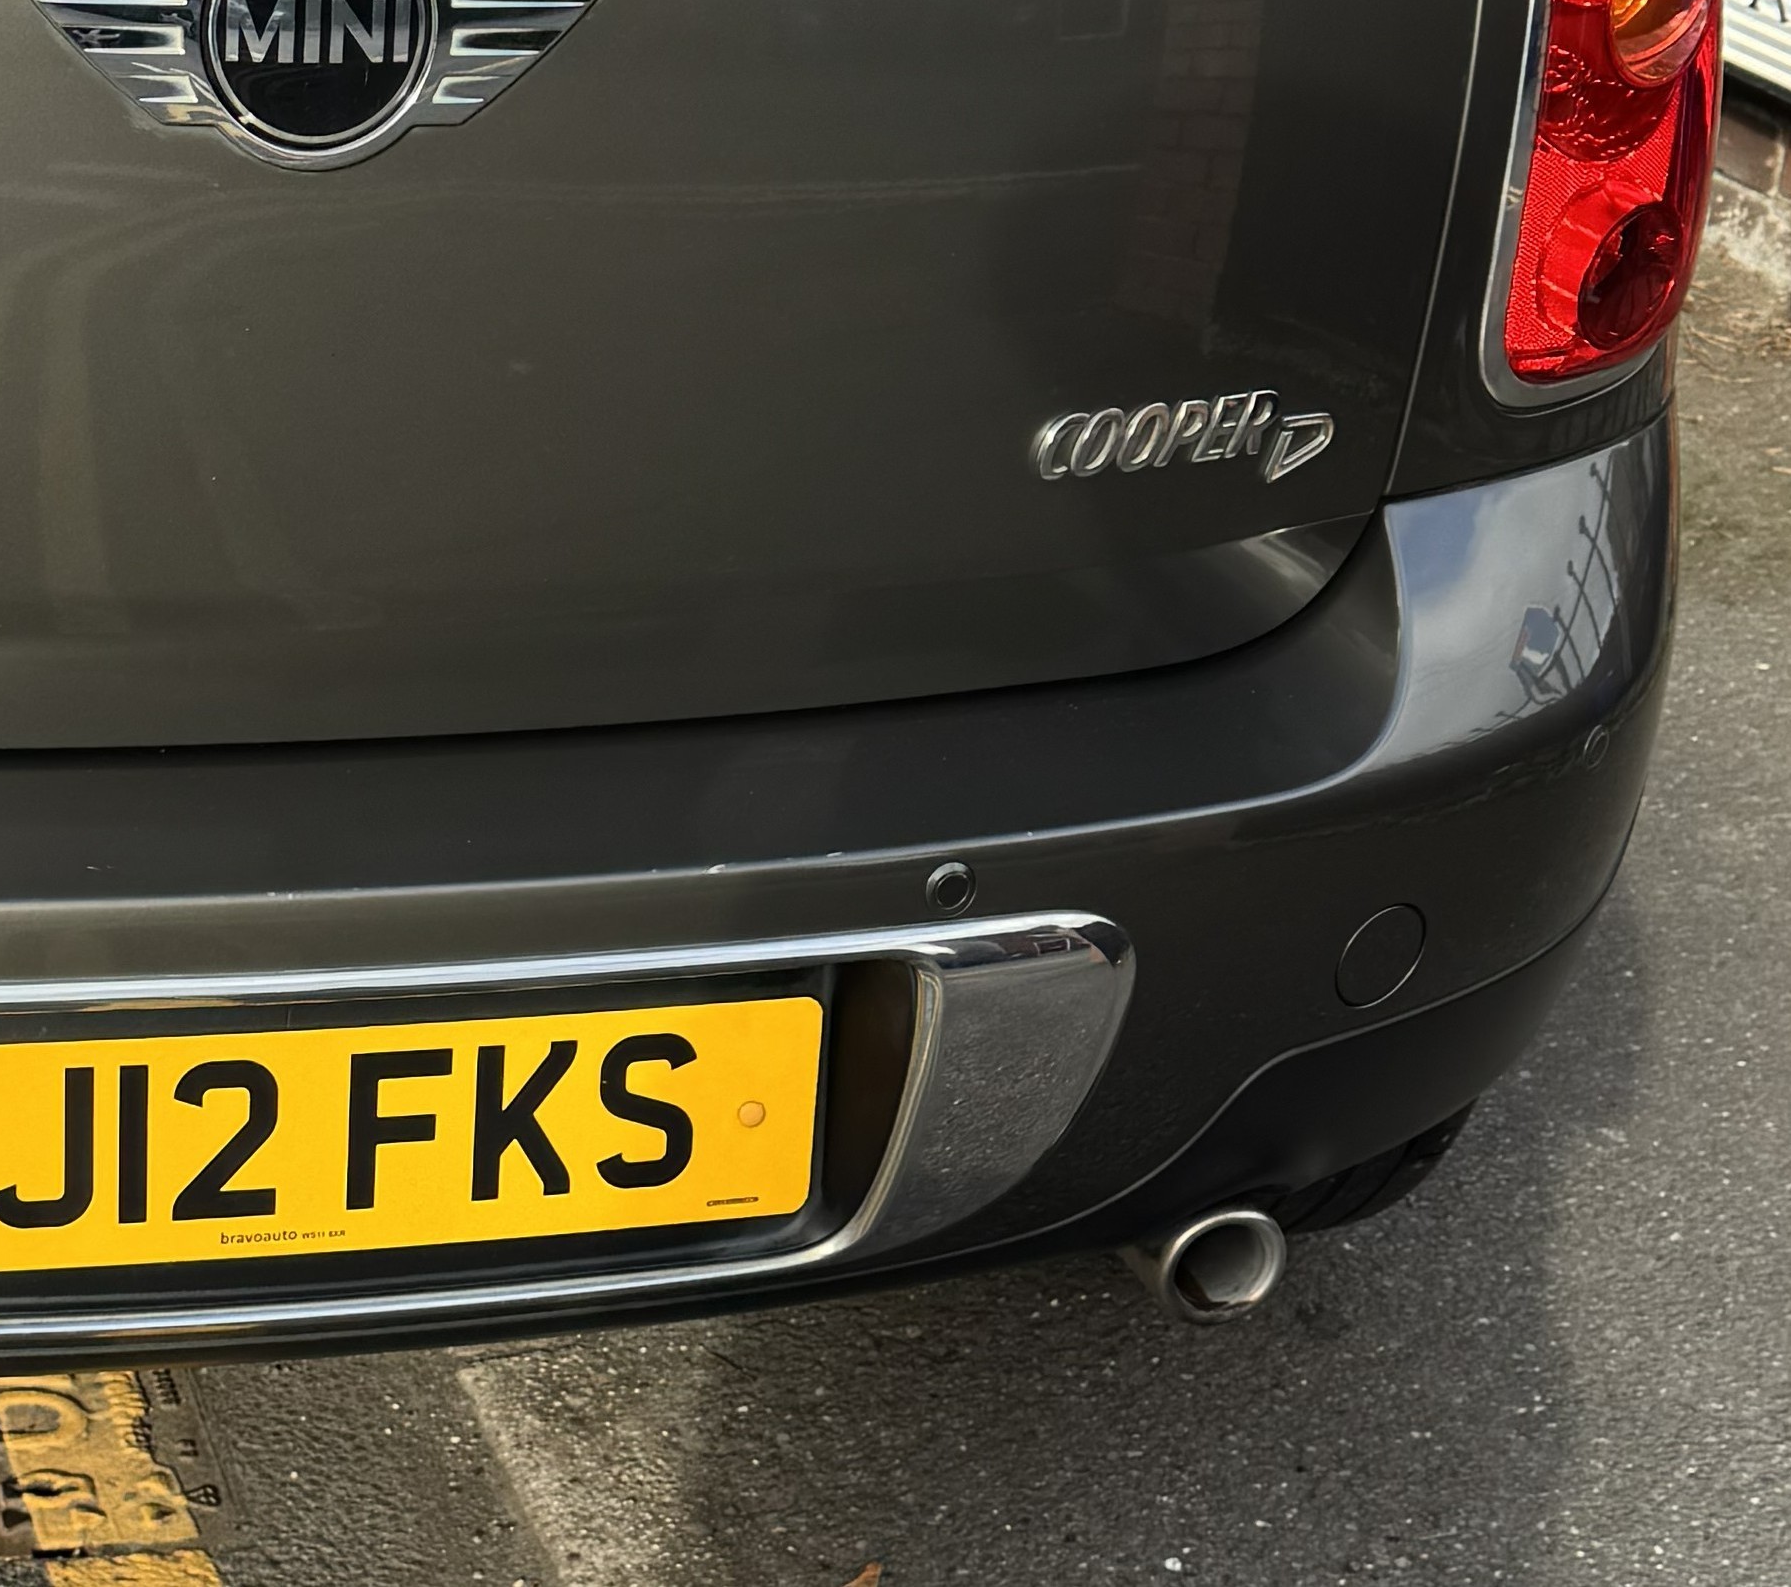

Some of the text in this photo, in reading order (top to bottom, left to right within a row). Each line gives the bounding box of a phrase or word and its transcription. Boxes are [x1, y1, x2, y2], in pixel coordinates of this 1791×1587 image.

[1034, 389, 1335, 484] COOPER D
[345, 1033, 697, 1210] FKS
[220, 1230, 298, 1244] bravoauto
